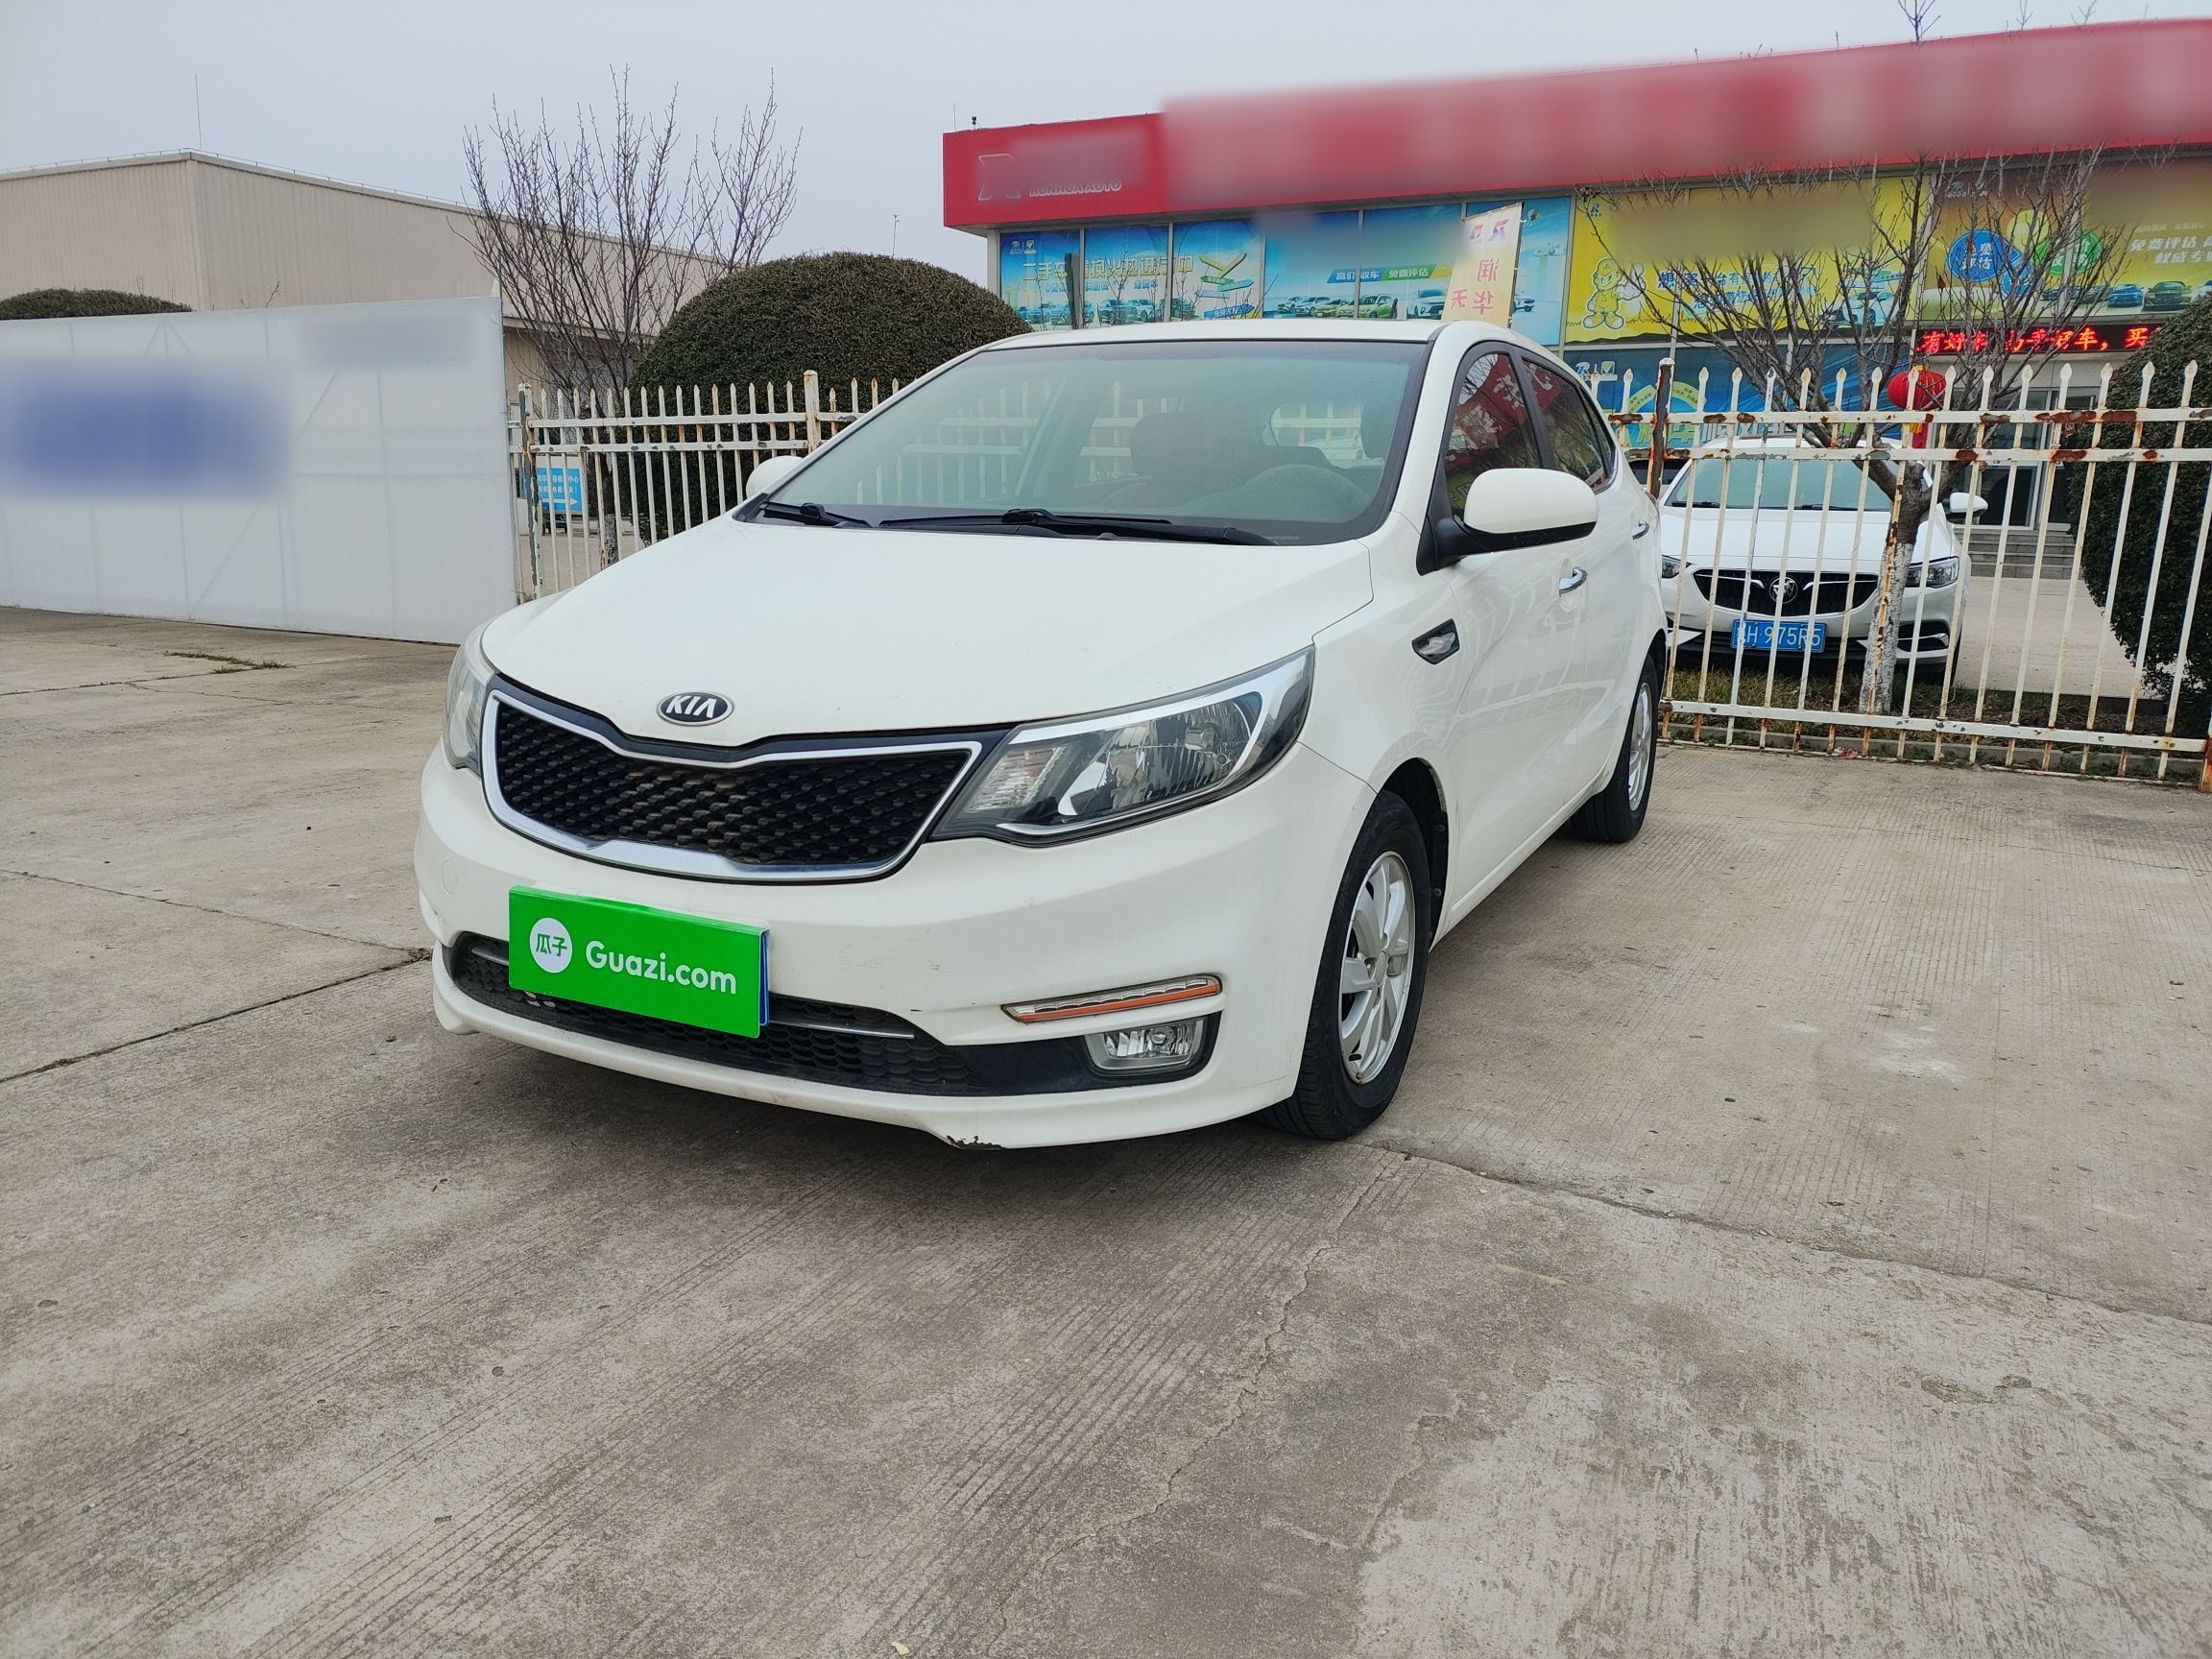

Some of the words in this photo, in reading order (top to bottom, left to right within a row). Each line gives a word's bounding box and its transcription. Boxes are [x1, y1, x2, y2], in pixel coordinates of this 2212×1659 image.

[1085, 180, 1121, 193] AUTO
[665, 695, 717, 718] KIA
[536, 933, 567, 957] 瓜子
[586, 940, 736, 995] Guazi.com
